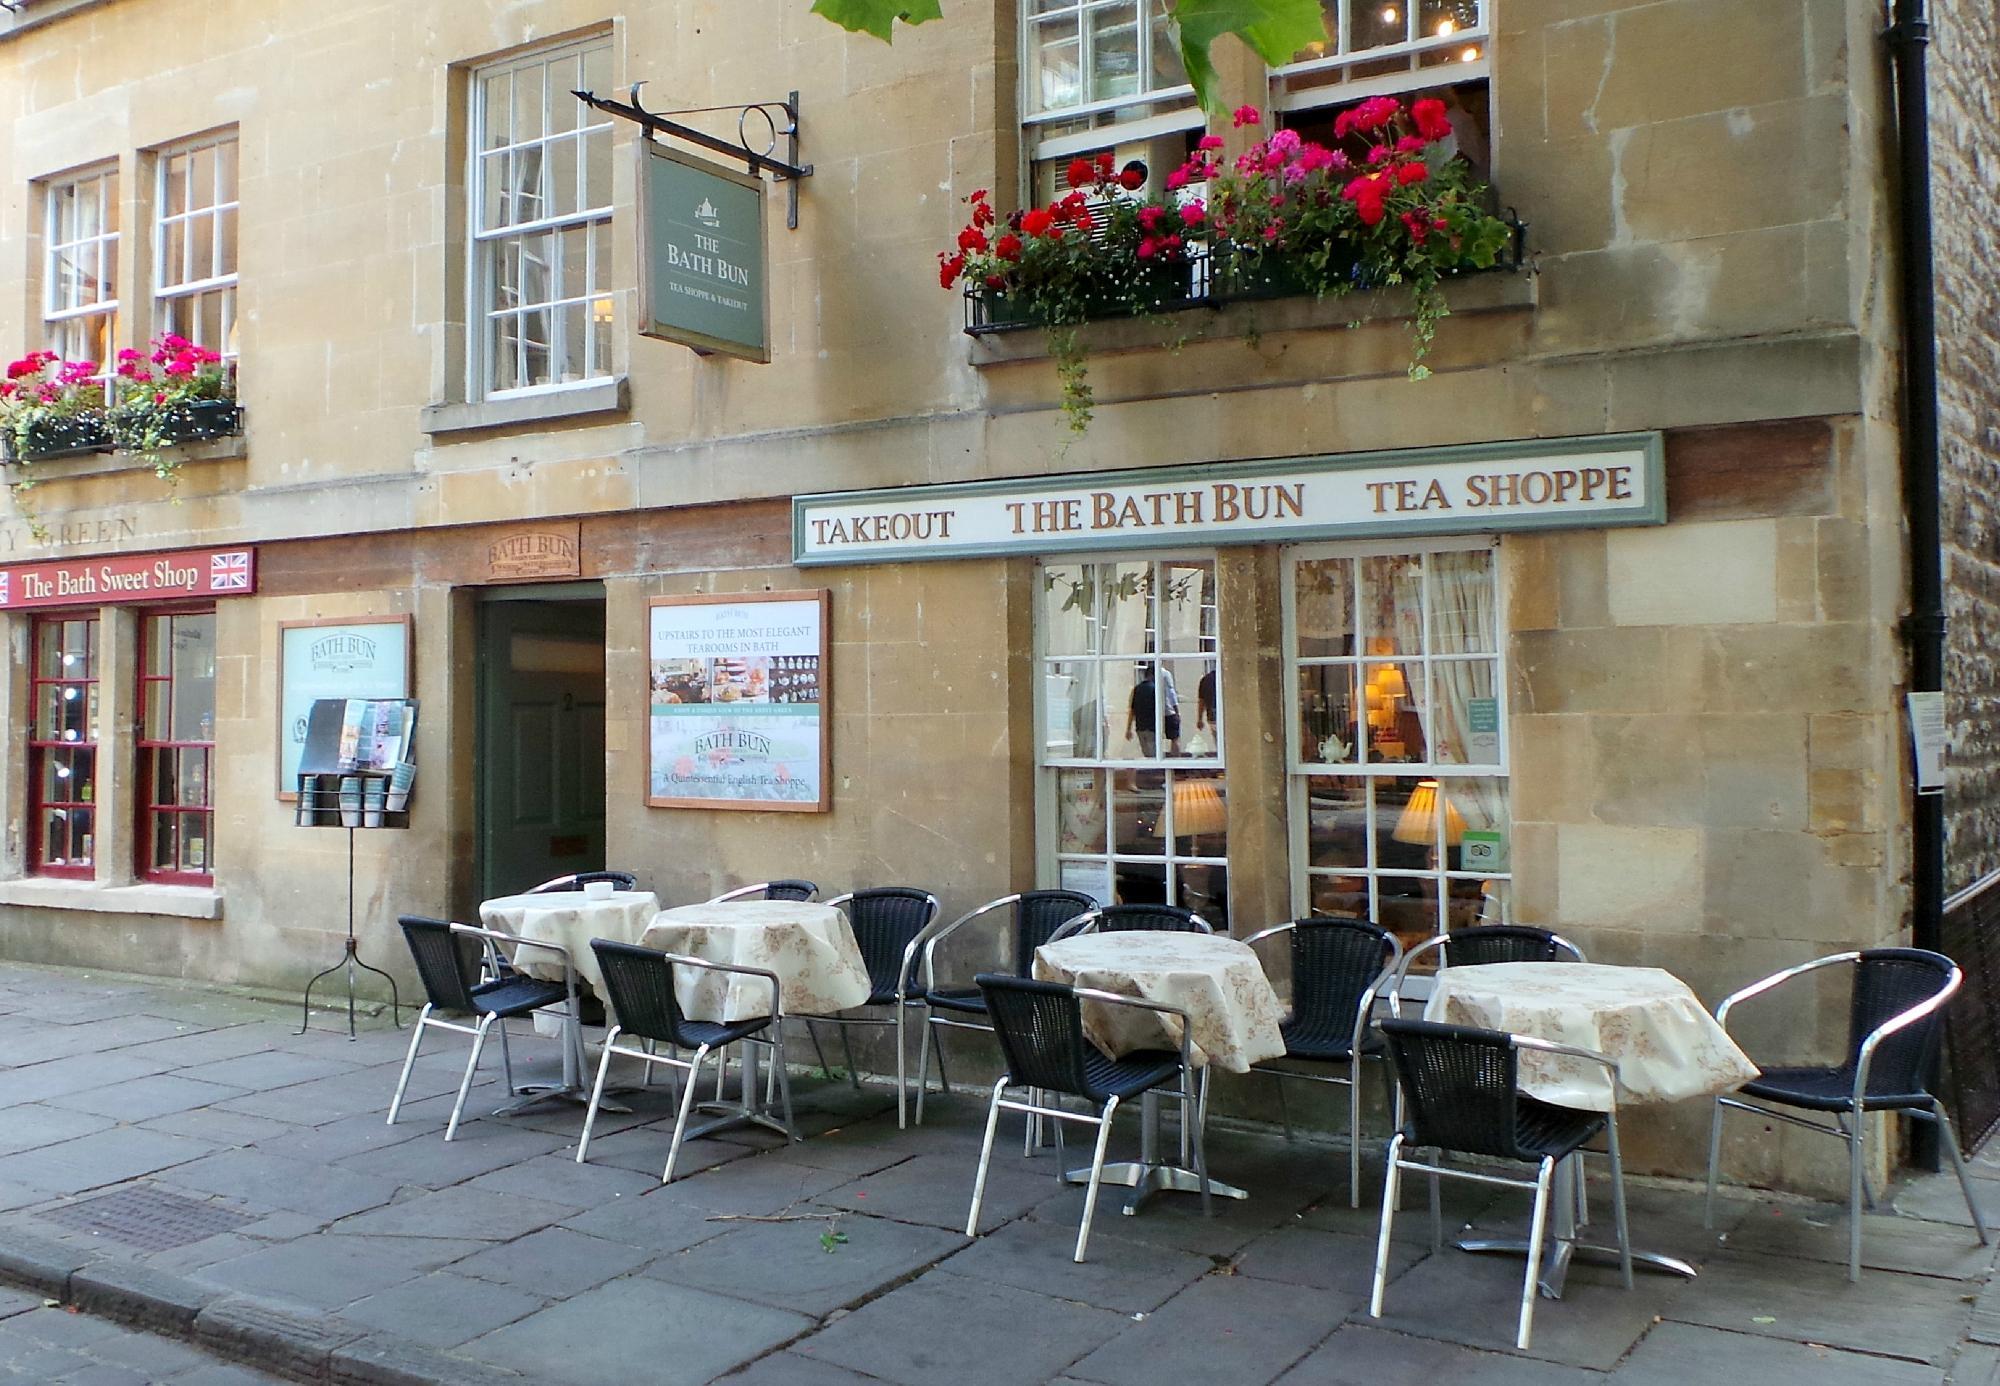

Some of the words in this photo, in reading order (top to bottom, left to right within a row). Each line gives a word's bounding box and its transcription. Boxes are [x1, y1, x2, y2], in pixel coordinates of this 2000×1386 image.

[694, 233, 720, 254] THE
[667, 243, 713, 275] BATH
[717, 258, 749, 287] BUN
[669, 281, 684, 294] TEA
[710, 293, 717, 303] &
[811, 511, 955, 546] TAKEOUT
[1006, 500, 1082, 534] THE
[1090, 491, 1203, 529] BATH
[1212, 483, 1304, 522] BUN
[1366, 479, 1451, 514] TEA
[1466, 467, 1632, 507] SHOPPE
[488, 534, 531, 565] BATH
[537, 534, 575, 560] BUN
[21, 572, 53, 600] The
[57, 567, 97, 596] Bath
[100, 565, 150, 593] Sweet
[153, 560, 199, 591] Shop
[658, 630, 700, 641] UPSTAIRS
[702, 630, 715, 639] TO
[717, 629, 736, 639] THE
[737, 628, 765, 638] MOST
[766, 626, 812, 638] ELEGANT
[311, 637, 344, 662] BATH
[347, 636, 377, 661] BUN
[688, 642, 738, 654] TEAROOMS
[740, 642, 751, 652] IN
[753, 641, 780, 652] BATH
[695, 732, 732, 754] BATH
[738, 733, 771, 755] BUN
[663, 774, 670, 782] A
[671, 773, 726, 784] Quintessential
[728, 774, 757, 787] English
[759, 776, 774, 786] Tea
[775, 776, 806, 790] Shoppe
